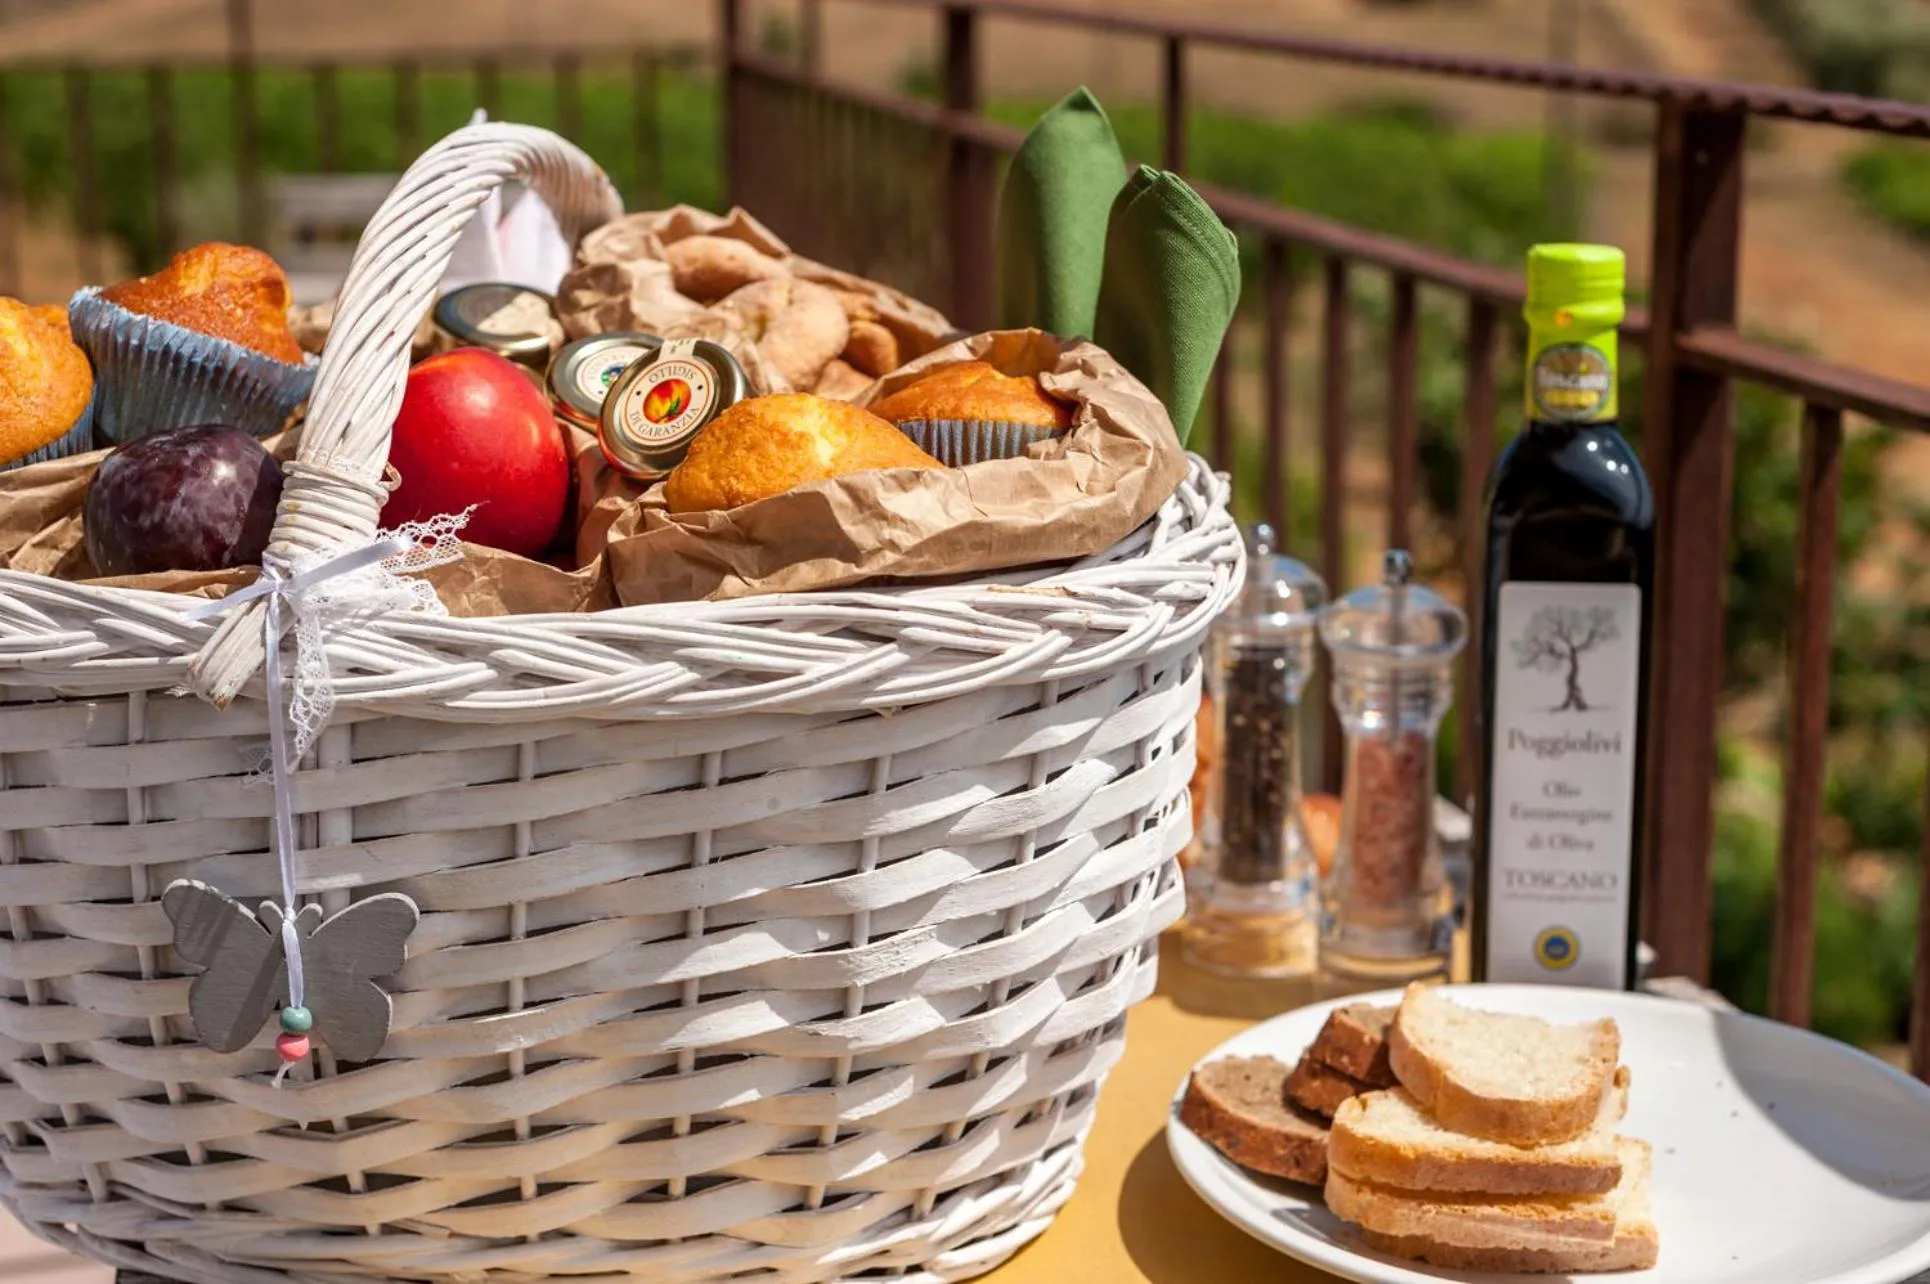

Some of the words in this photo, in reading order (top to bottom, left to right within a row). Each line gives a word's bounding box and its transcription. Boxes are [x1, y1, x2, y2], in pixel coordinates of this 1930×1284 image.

[649, 364, 697, 384] SIGILLO
[639, 407, 700, 437] GARANZIA
[1507, 728, 1621, 760] Poggiolivi
[1505, 868, 1618, 889] TOSCANO
